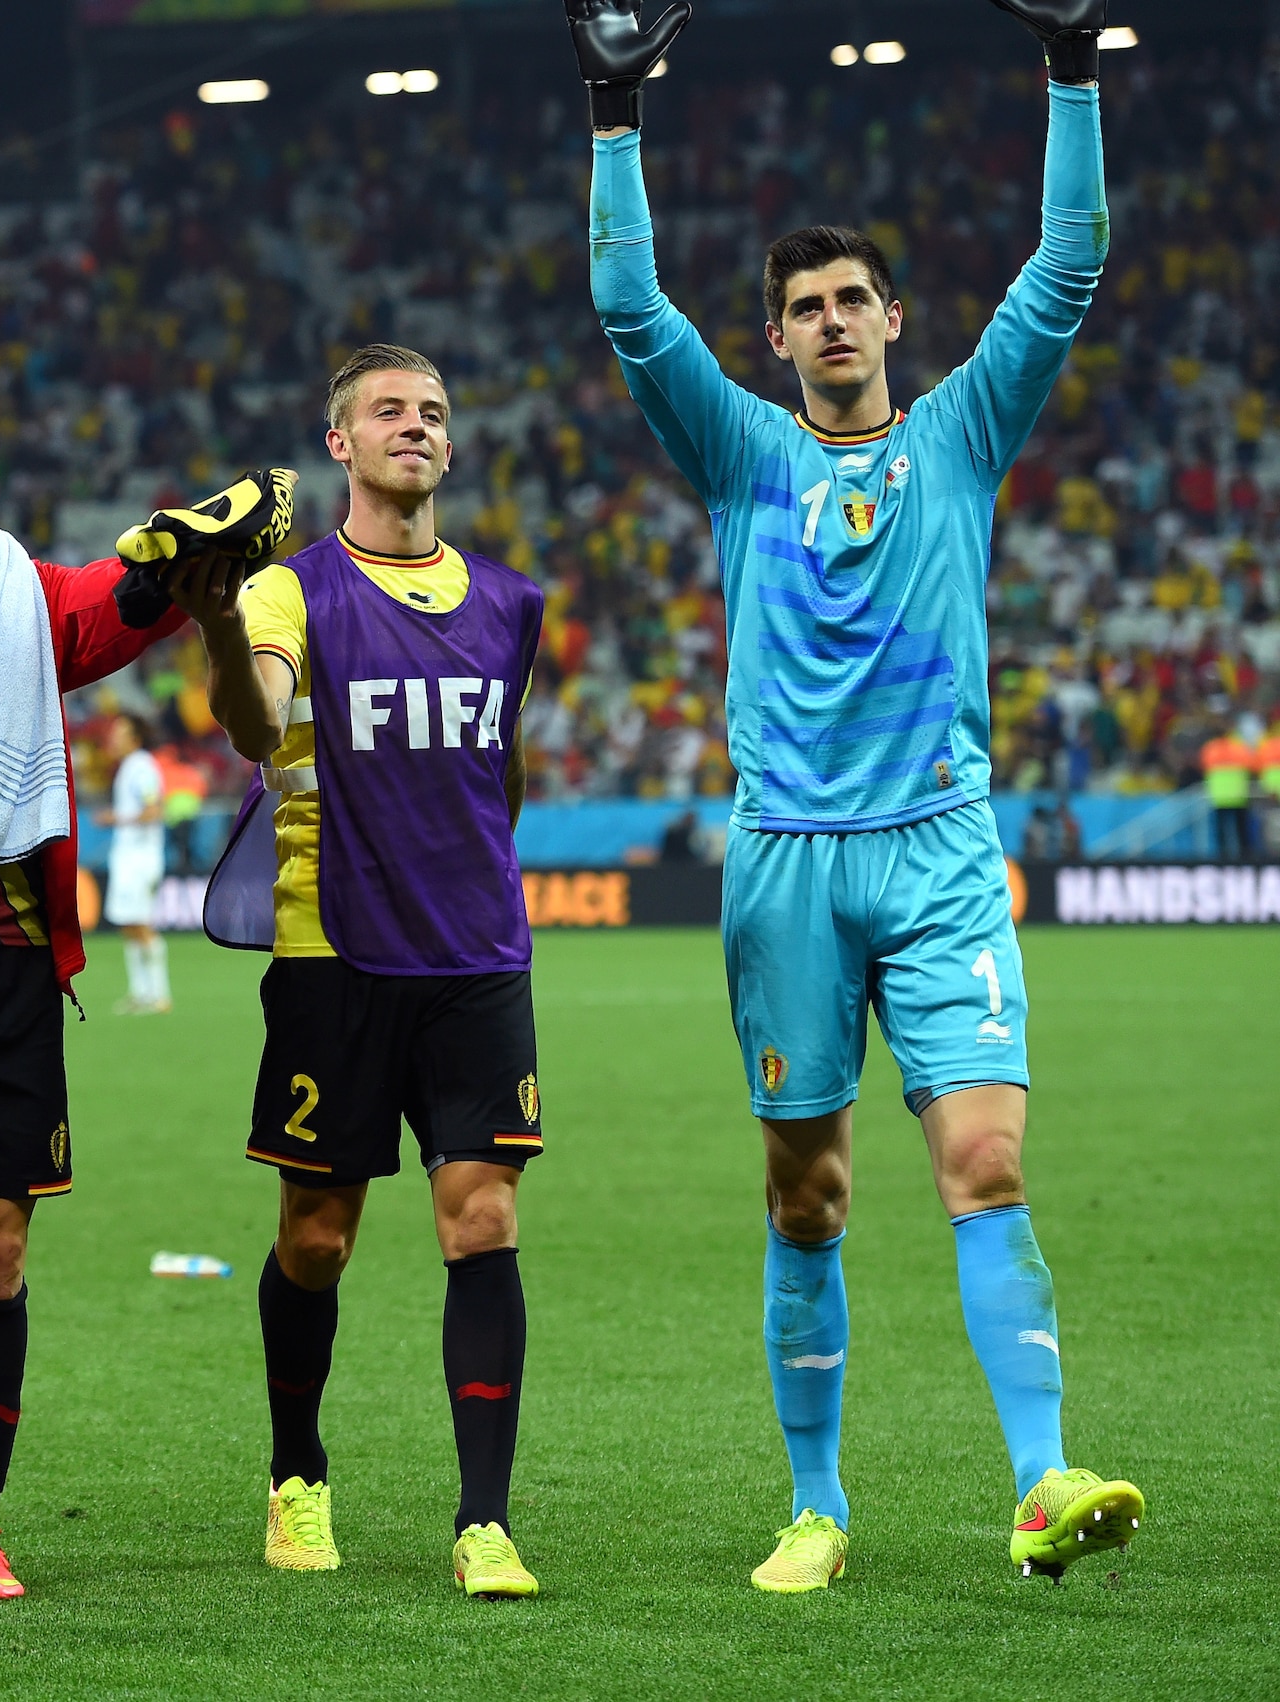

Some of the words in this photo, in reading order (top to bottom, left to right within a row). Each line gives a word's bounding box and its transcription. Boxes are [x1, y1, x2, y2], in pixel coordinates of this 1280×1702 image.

[800, 480, 830, 546] 1
[348, 677, 505, 751] FIFA
[971, 949, 1002, 1016] 1
[284, 1073, 320, 1143] 2
